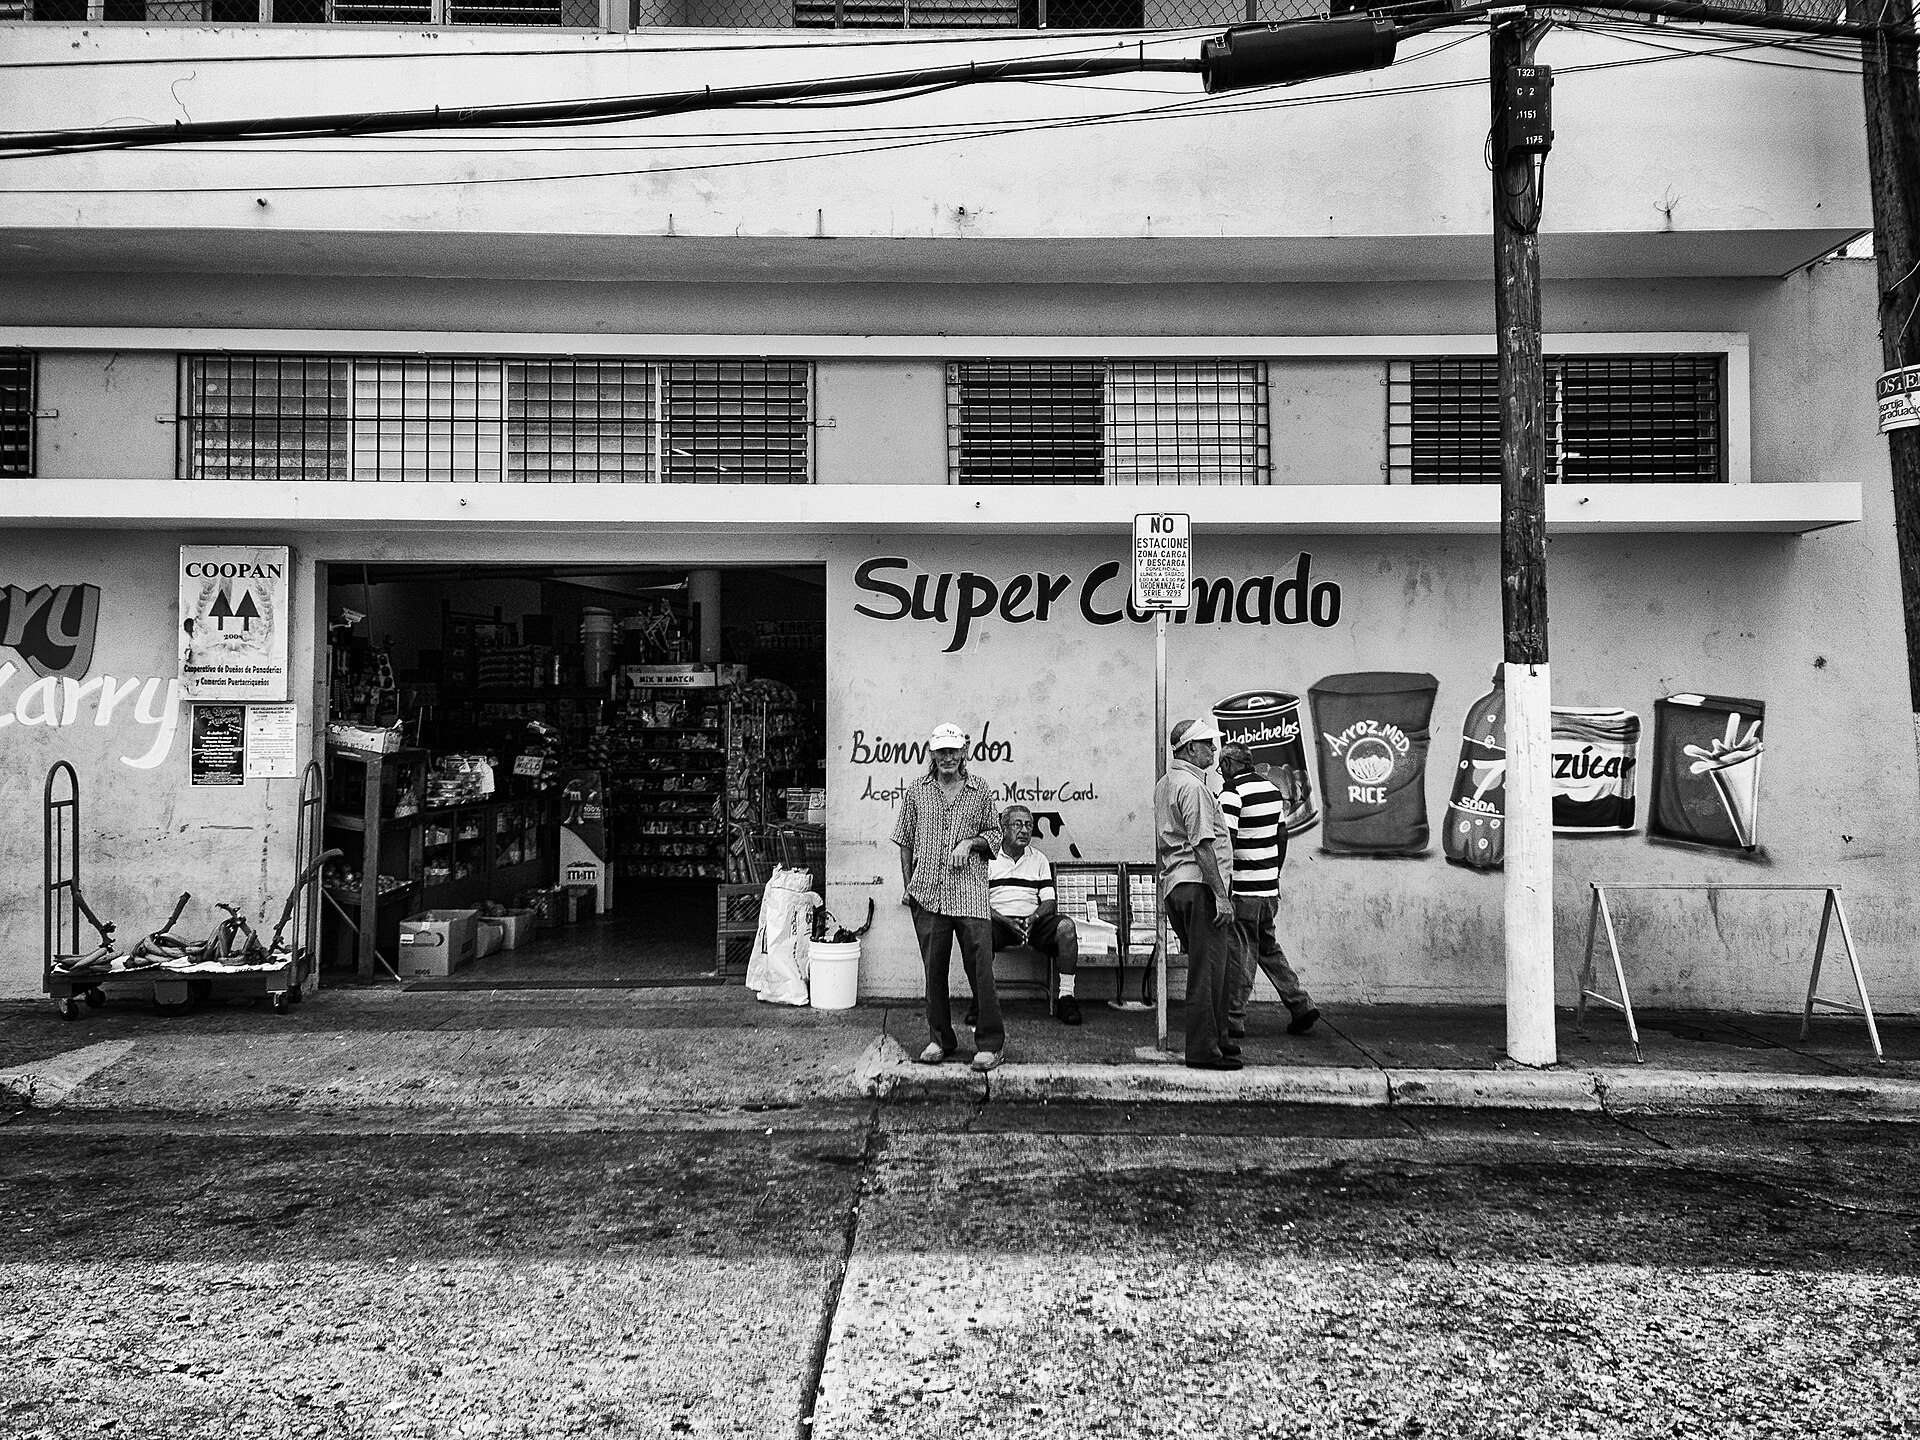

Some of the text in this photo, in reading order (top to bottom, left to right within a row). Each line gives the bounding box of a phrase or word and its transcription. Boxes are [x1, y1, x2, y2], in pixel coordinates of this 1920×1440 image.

[1517, 68, 1535, 77] T323
[1517, 87, 1535, 96] C 2
[1519, 110, 1537, 119] 1151
[1526, 135, 1543, 145] 1175
[1150, 517, 1174, 533] NO
[1137, 538, 1188, 548] ESTACIONE
[185, 562, 282, 578] COOPAN
[854, 552, 1340, 652] Super Cmado
[184, 665, 215, 674] Cooperativa
[217, 665, 223, 673] de
[245, 665, 251, 673] de
[201, 677, 226, 685] Comercios
[1225, 717, 1299, 744] Habichuelas
[1347, 785, 1388, 804] RICE
